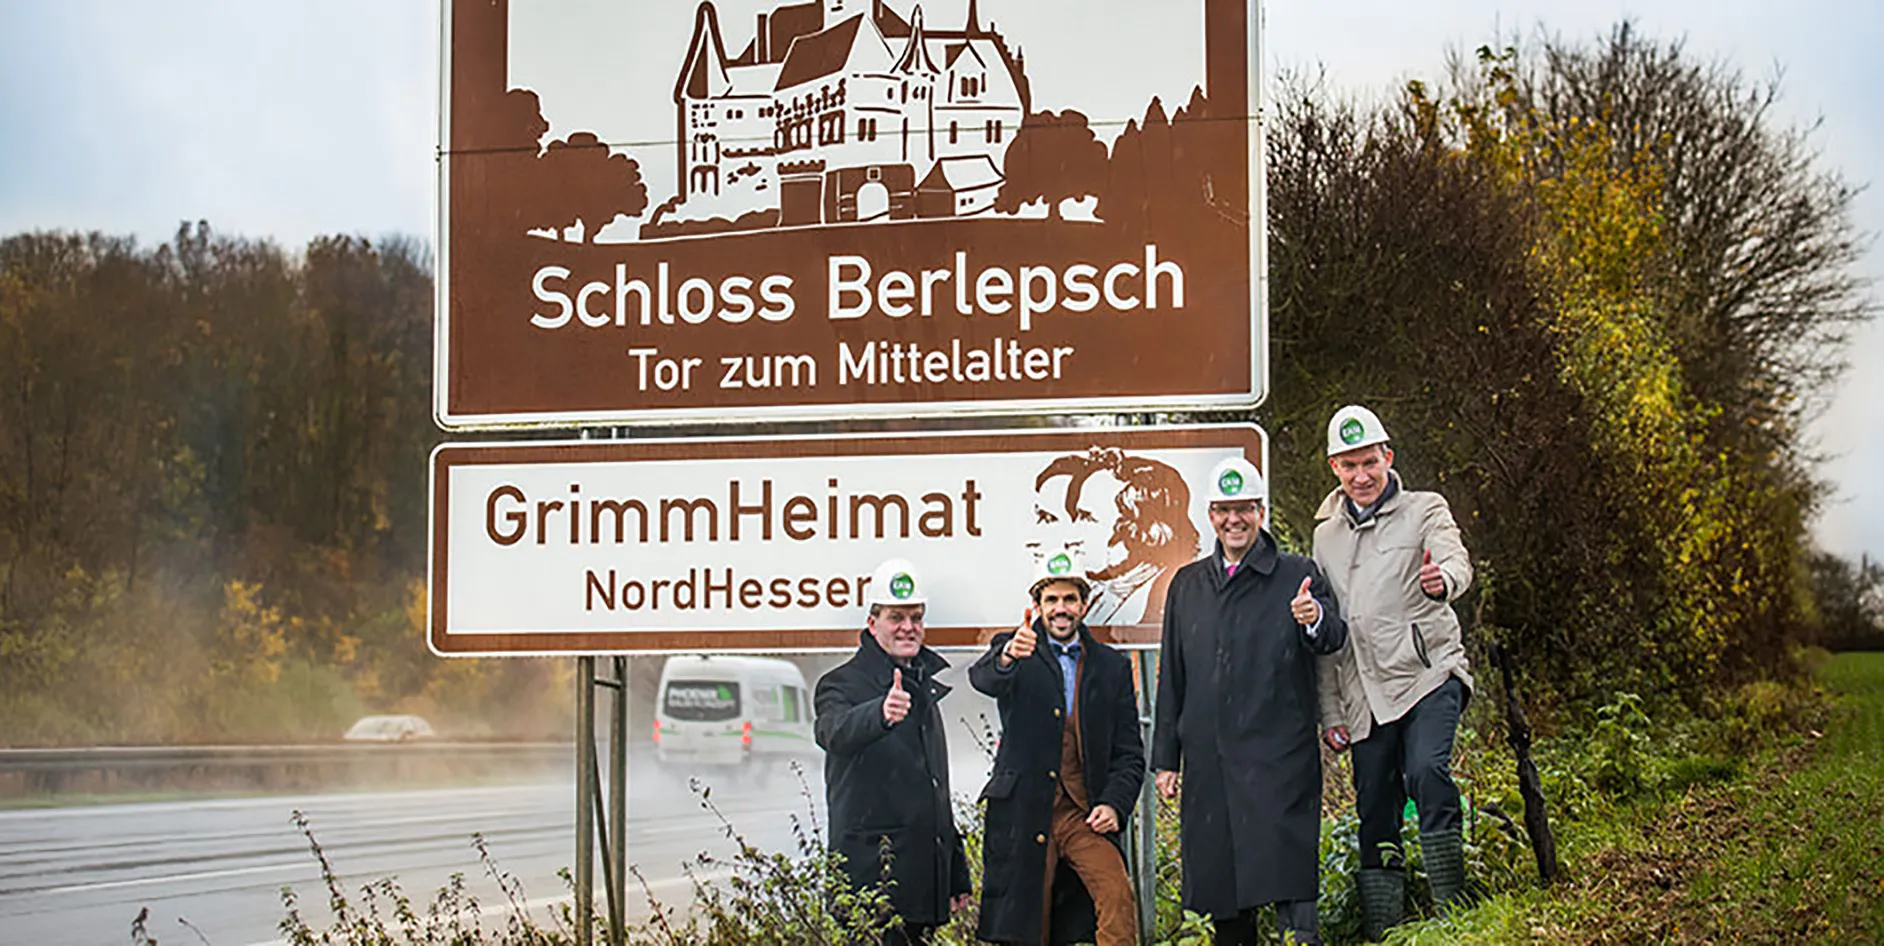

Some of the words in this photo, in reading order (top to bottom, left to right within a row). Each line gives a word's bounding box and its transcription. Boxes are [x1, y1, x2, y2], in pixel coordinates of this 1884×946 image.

[530, 262, 796, 329] Schloss
[828, 244, 1184, 331] Berlepsch
[628, 348, 703, 391] Tor
[719, 354, 816, 388] zum
[839, 337, 1075, 385] Mittelalter
[486, 479, 982, 546] GrimmHeimat
